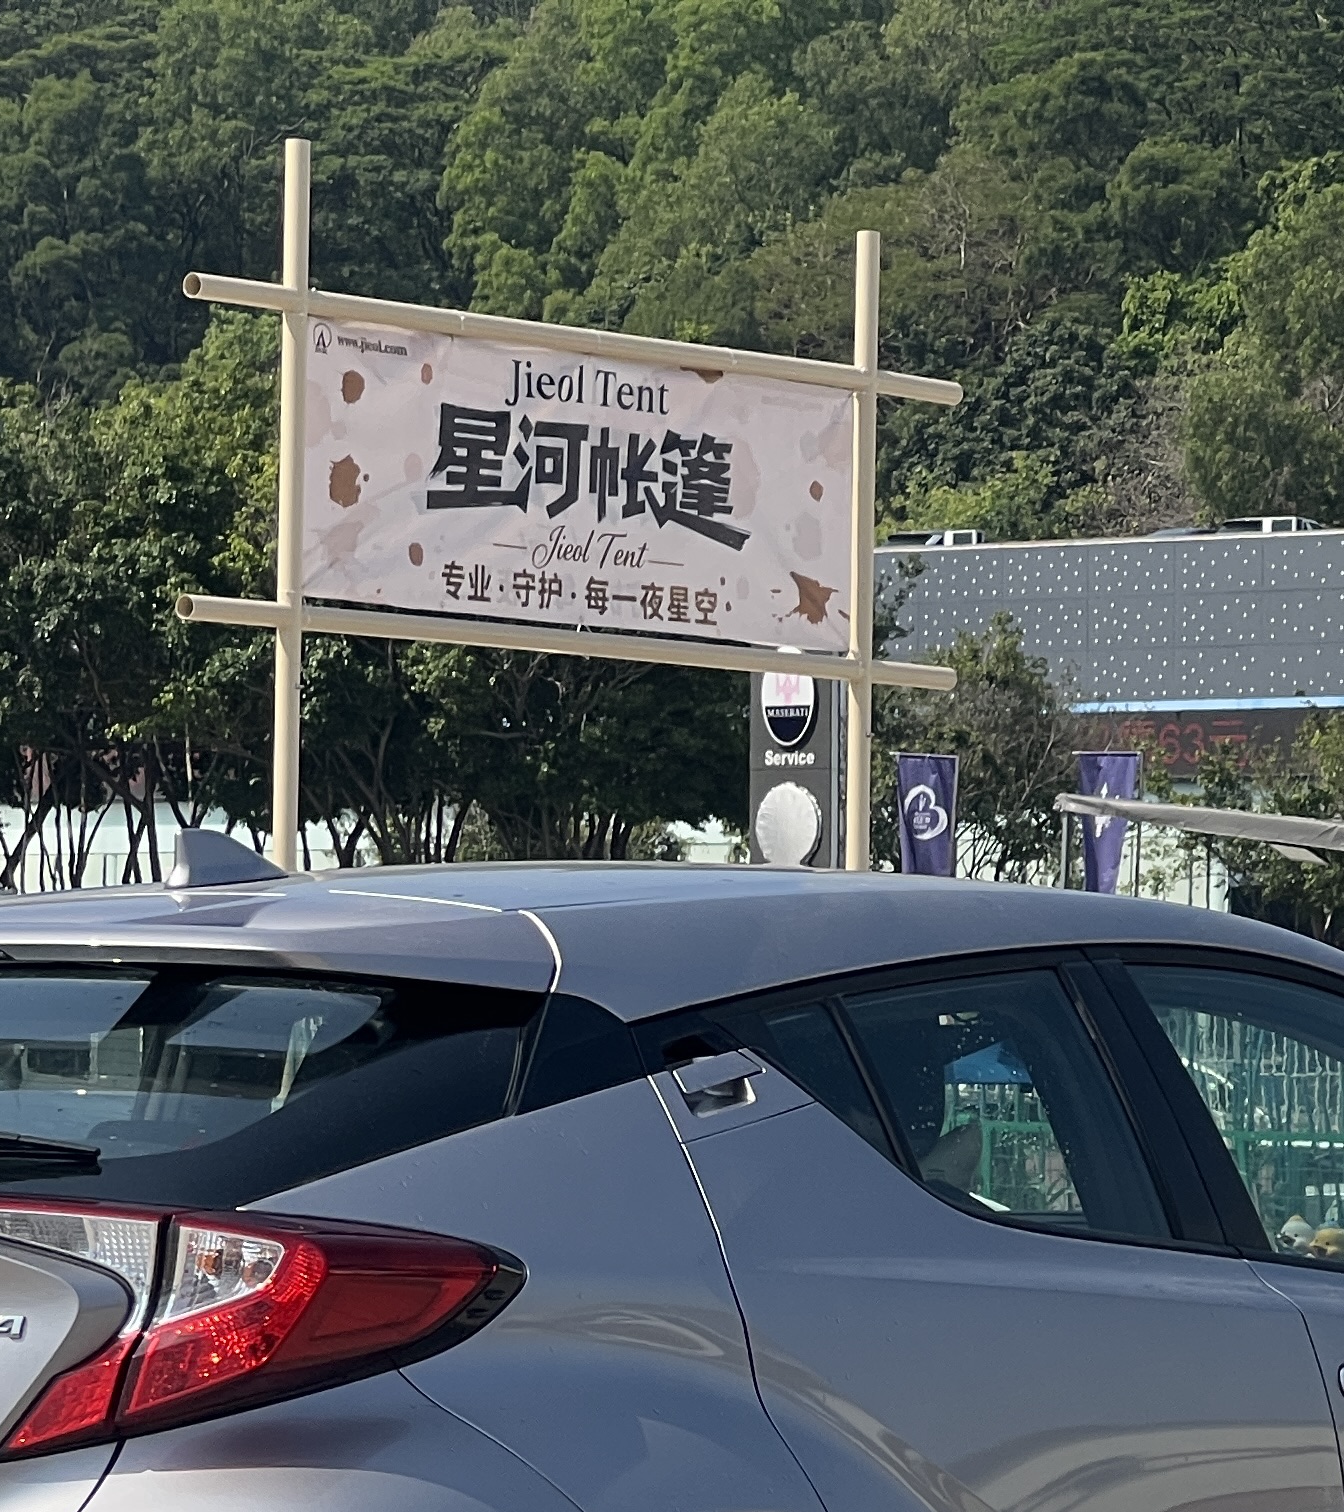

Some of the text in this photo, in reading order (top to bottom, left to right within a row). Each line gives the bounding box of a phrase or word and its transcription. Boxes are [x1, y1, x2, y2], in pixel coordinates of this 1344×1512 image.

[505, 359, 670, 415] Jieol Tent
[426, 402, 751, 551] 星河帐篷
[532, 525, 649, 569] Jieol Tent
[764, 750, 815, 766] Service
